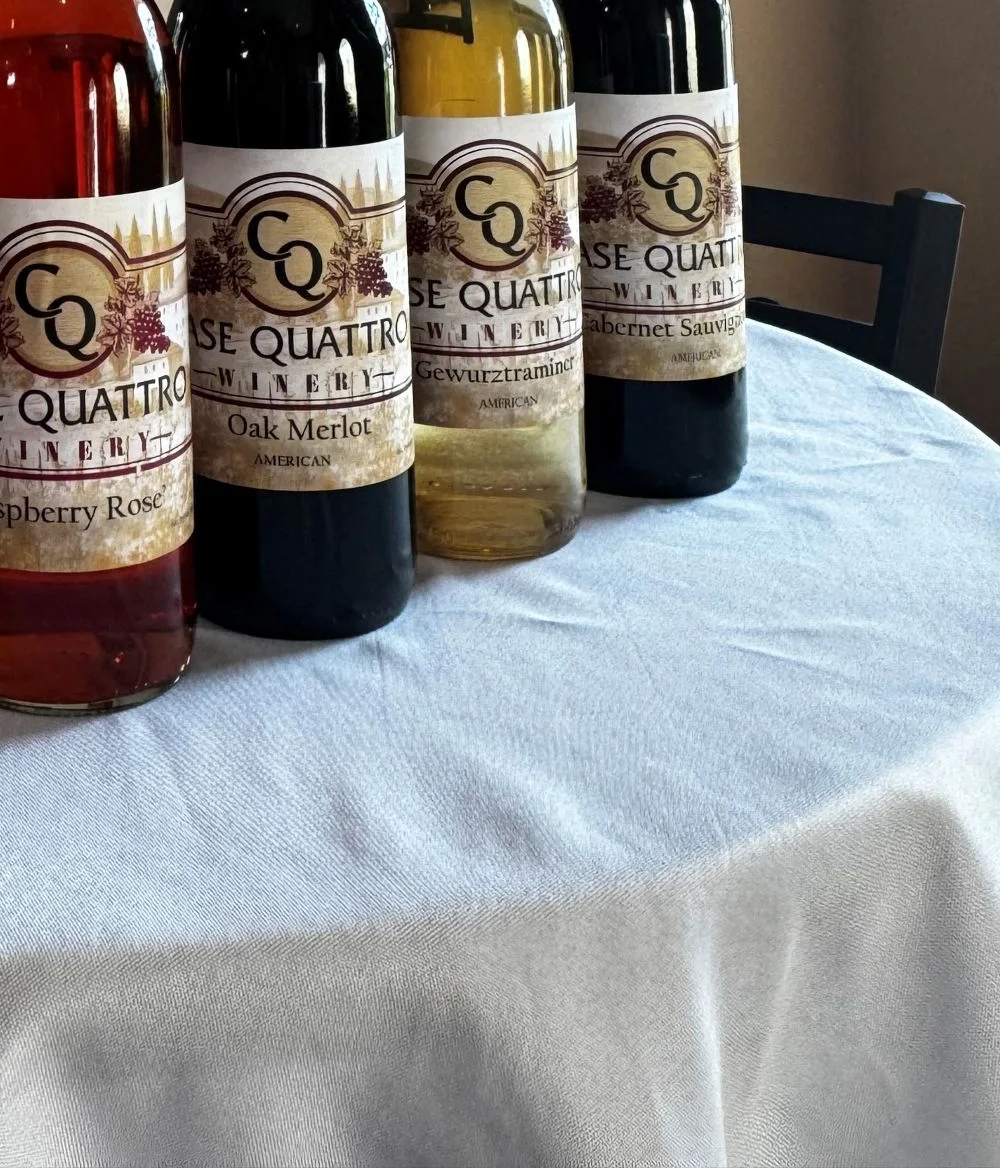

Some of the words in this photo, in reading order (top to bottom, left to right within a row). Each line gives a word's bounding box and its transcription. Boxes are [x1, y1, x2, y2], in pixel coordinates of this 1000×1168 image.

[580, 239, 632, 270] ASE
[644, 235, 741, 278] QUATT
[613, 277, 736, 300] WINERY
[250, 310, 408, 367] QUATTRO
[426, 314, 563, 341] WINERY
[218, 366, 373, 393] WINERY
[415, 353, 575, 383] Gewurztraminer
[18, 365, 187, 434] QUATTRO
[479, 395, 539, 410] AMERICAN
[228, 413, 280, 440] Oak
[288, 415, 372, 441] Merlot
[254, 453, 332, 468] AMERICAN
